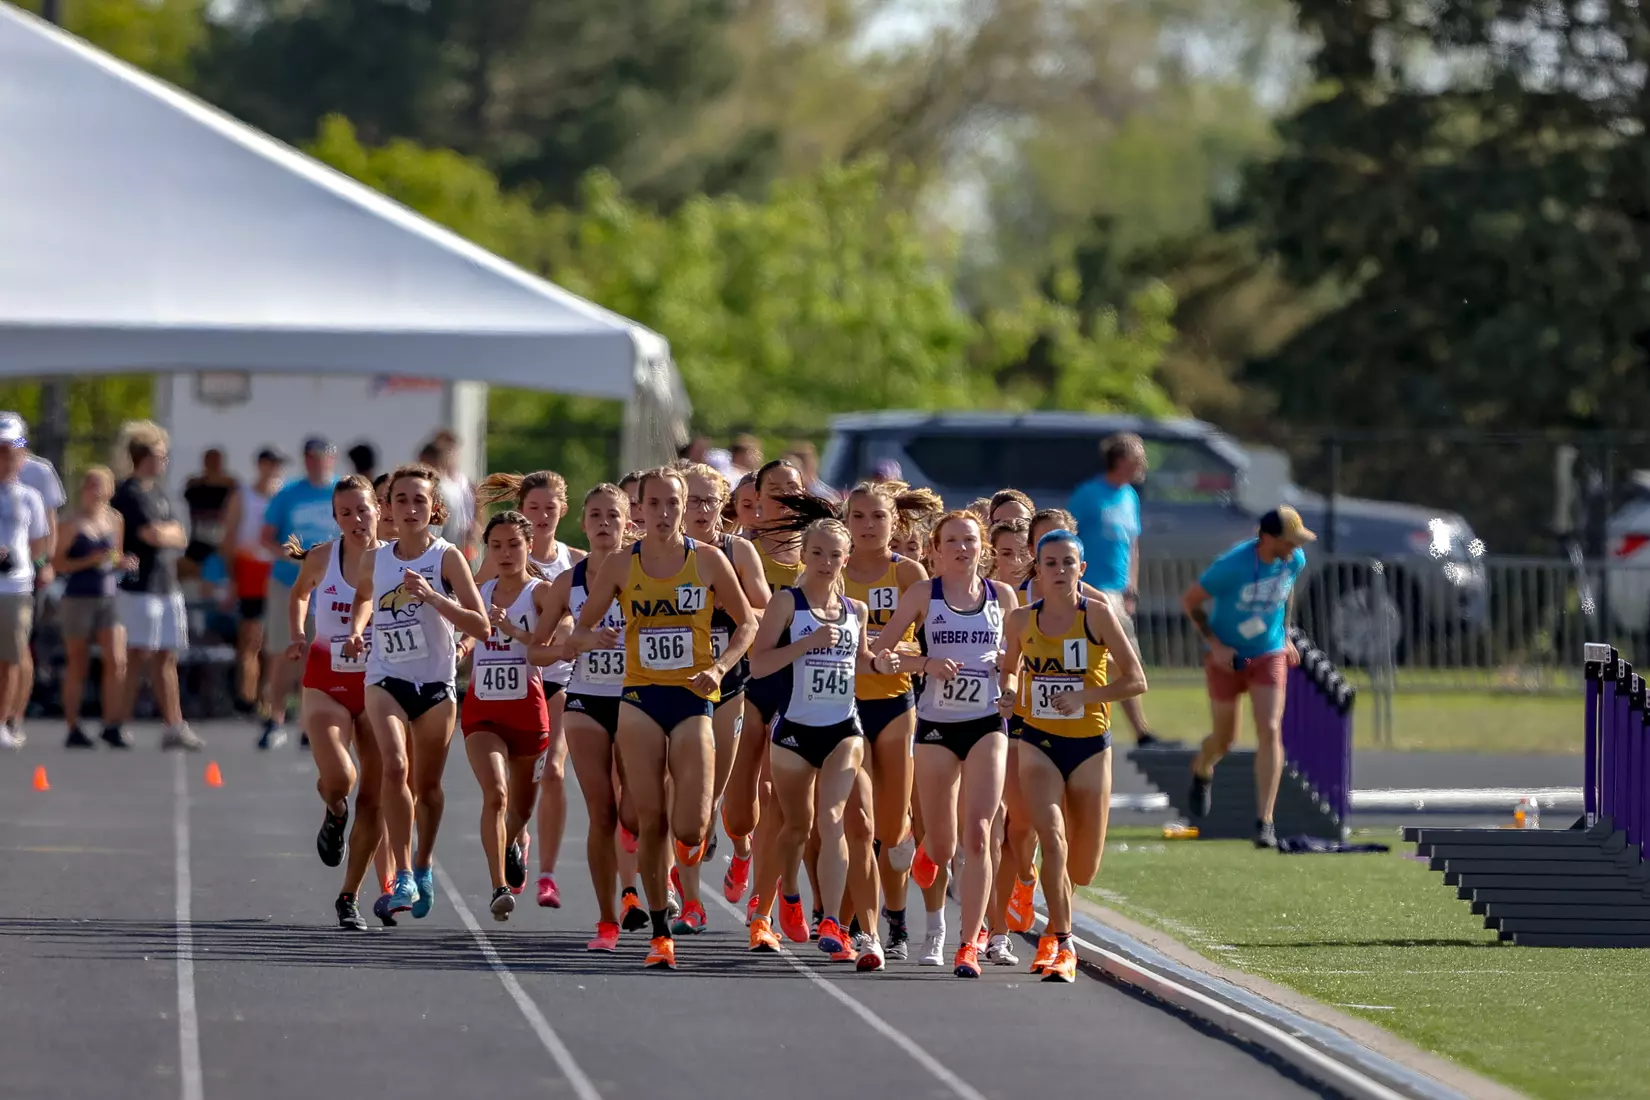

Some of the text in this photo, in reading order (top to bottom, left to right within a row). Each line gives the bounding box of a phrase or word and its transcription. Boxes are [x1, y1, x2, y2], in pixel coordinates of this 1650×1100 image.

[682, 588, 701, 609] 21
[873, 587, 894, 608] 13
[988, 602, 1000, 629] 6
[383, 628, 418, 654] 311
[645, 634, 685, 660] 366
[931, 630, 1000, 645] WEBER STATE
[588, 651, 625, 675] 533
[1069, 640, 1081, 668] 1
[482, 666, 519, 691] 469
[811, 668, 849, 695] 545
[942, 677, 982, 703] 522
